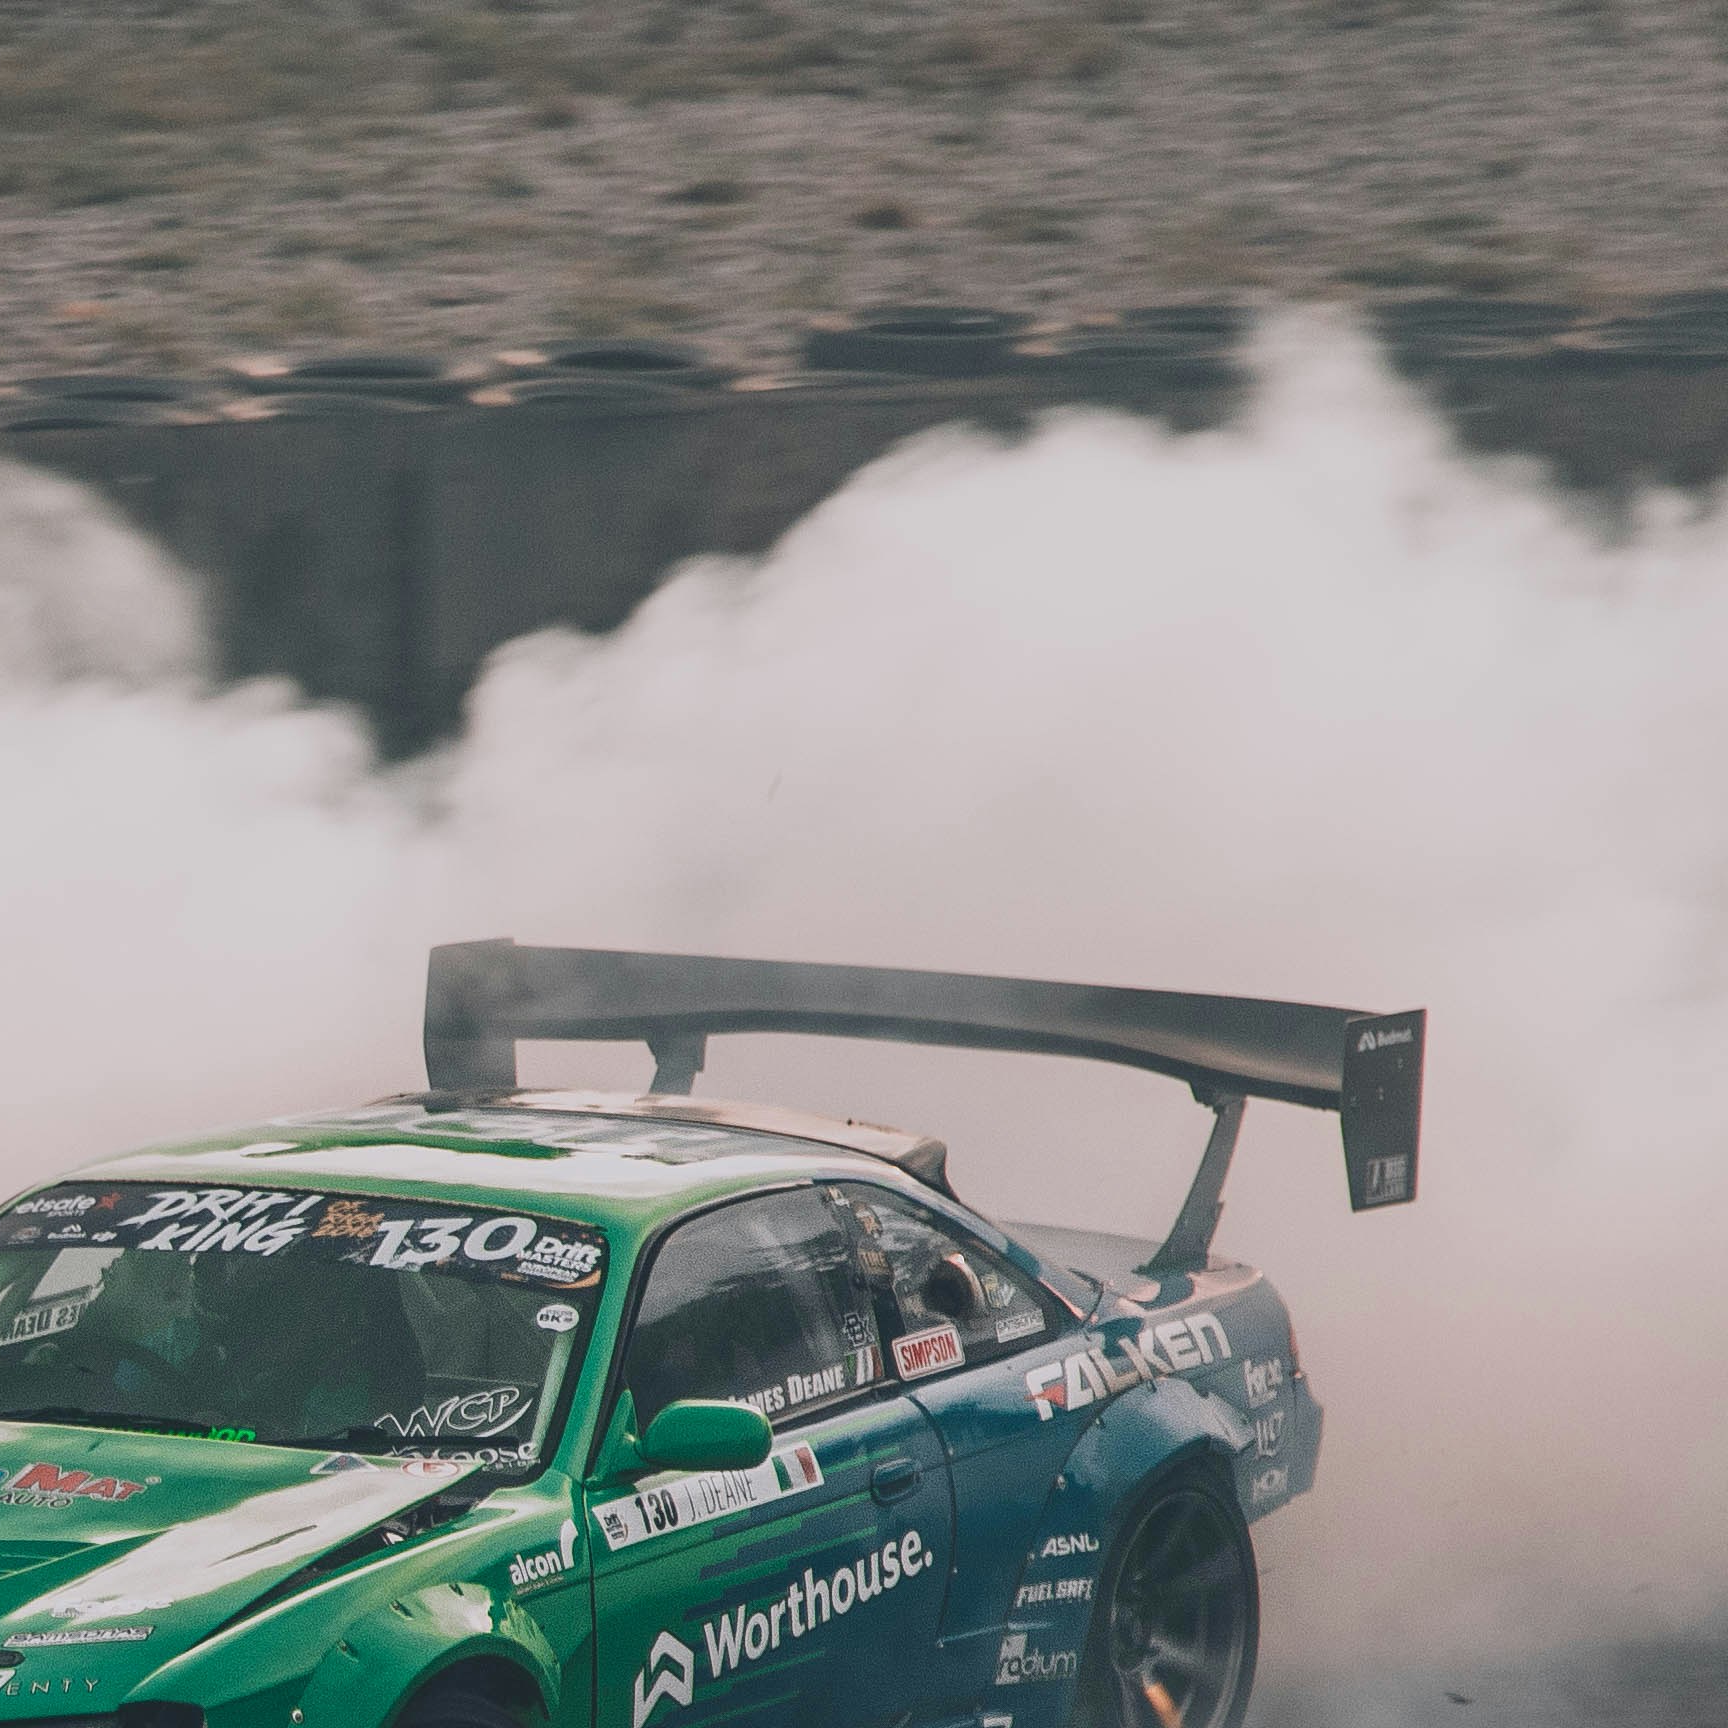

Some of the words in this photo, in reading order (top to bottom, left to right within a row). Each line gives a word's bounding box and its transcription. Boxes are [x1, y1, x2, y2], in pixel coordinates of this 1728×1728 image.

[117, 1189, 325, 1230] DRIFT
[137, 1216, 312, 1256] KING
[369, 1216, 537, 1272] 130
[534, 1236, 602, 1265] Drift
[516, 1250, 593, 1274] MASTERS
[900, 1331, 959, 1373] SIMPSON
[1024, 1311, 1232, 1421] FALKEN
[787, 1363, 845, 1405] DEANE
[634, 1488, 680, 1534] 130
[685, 1484, 702, 1522] J.
[699, 1469, 758, 1516] DEANE
[509, 1551, 563, 1586] alcon
[703, 1530, 933, 1679] Worthouse.
